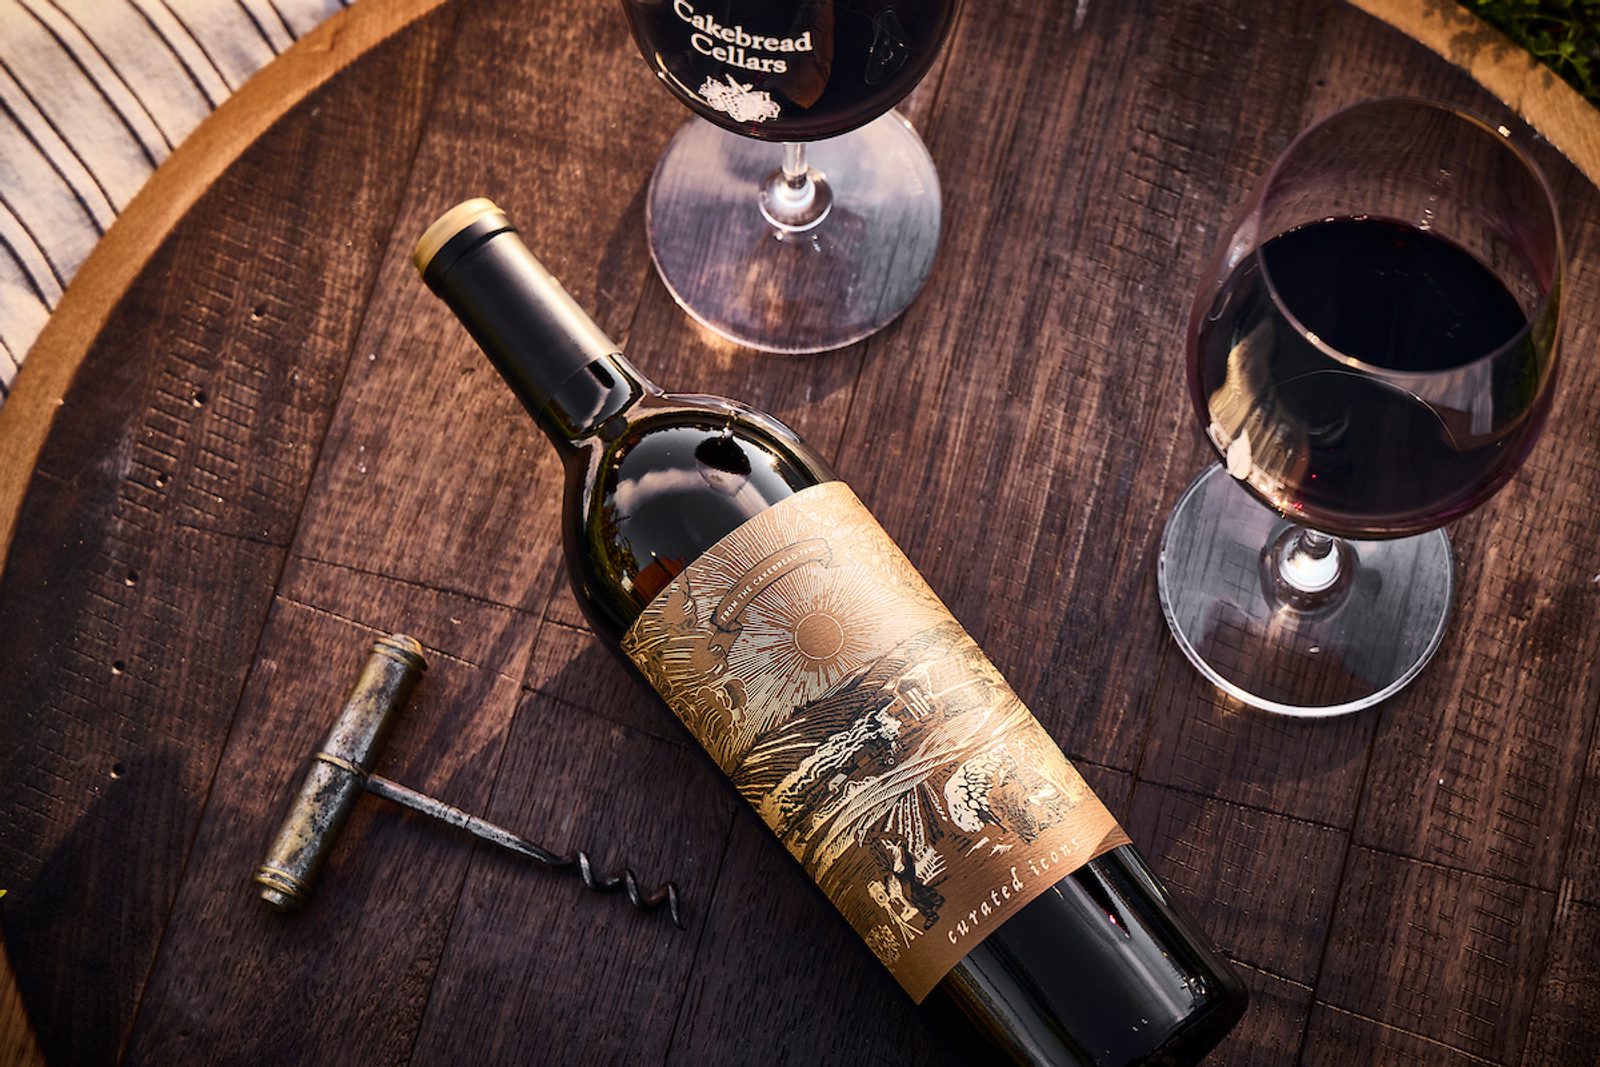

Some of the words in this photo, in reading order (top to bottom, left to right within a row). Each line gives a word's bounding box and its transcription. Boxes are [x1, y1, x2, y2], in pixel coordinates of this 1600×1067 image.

[673, 0, 813, 52] Cakebread
[690, 33, 788, 74] Cellars
[720, 600, 739, 622] FROM
[737, 585, 754, 601] THE
[753, 553, 798, 586] CAKEBREAD
[947, 866, 1024, 945] curated
[1028, 837, 1081, 877] icons
